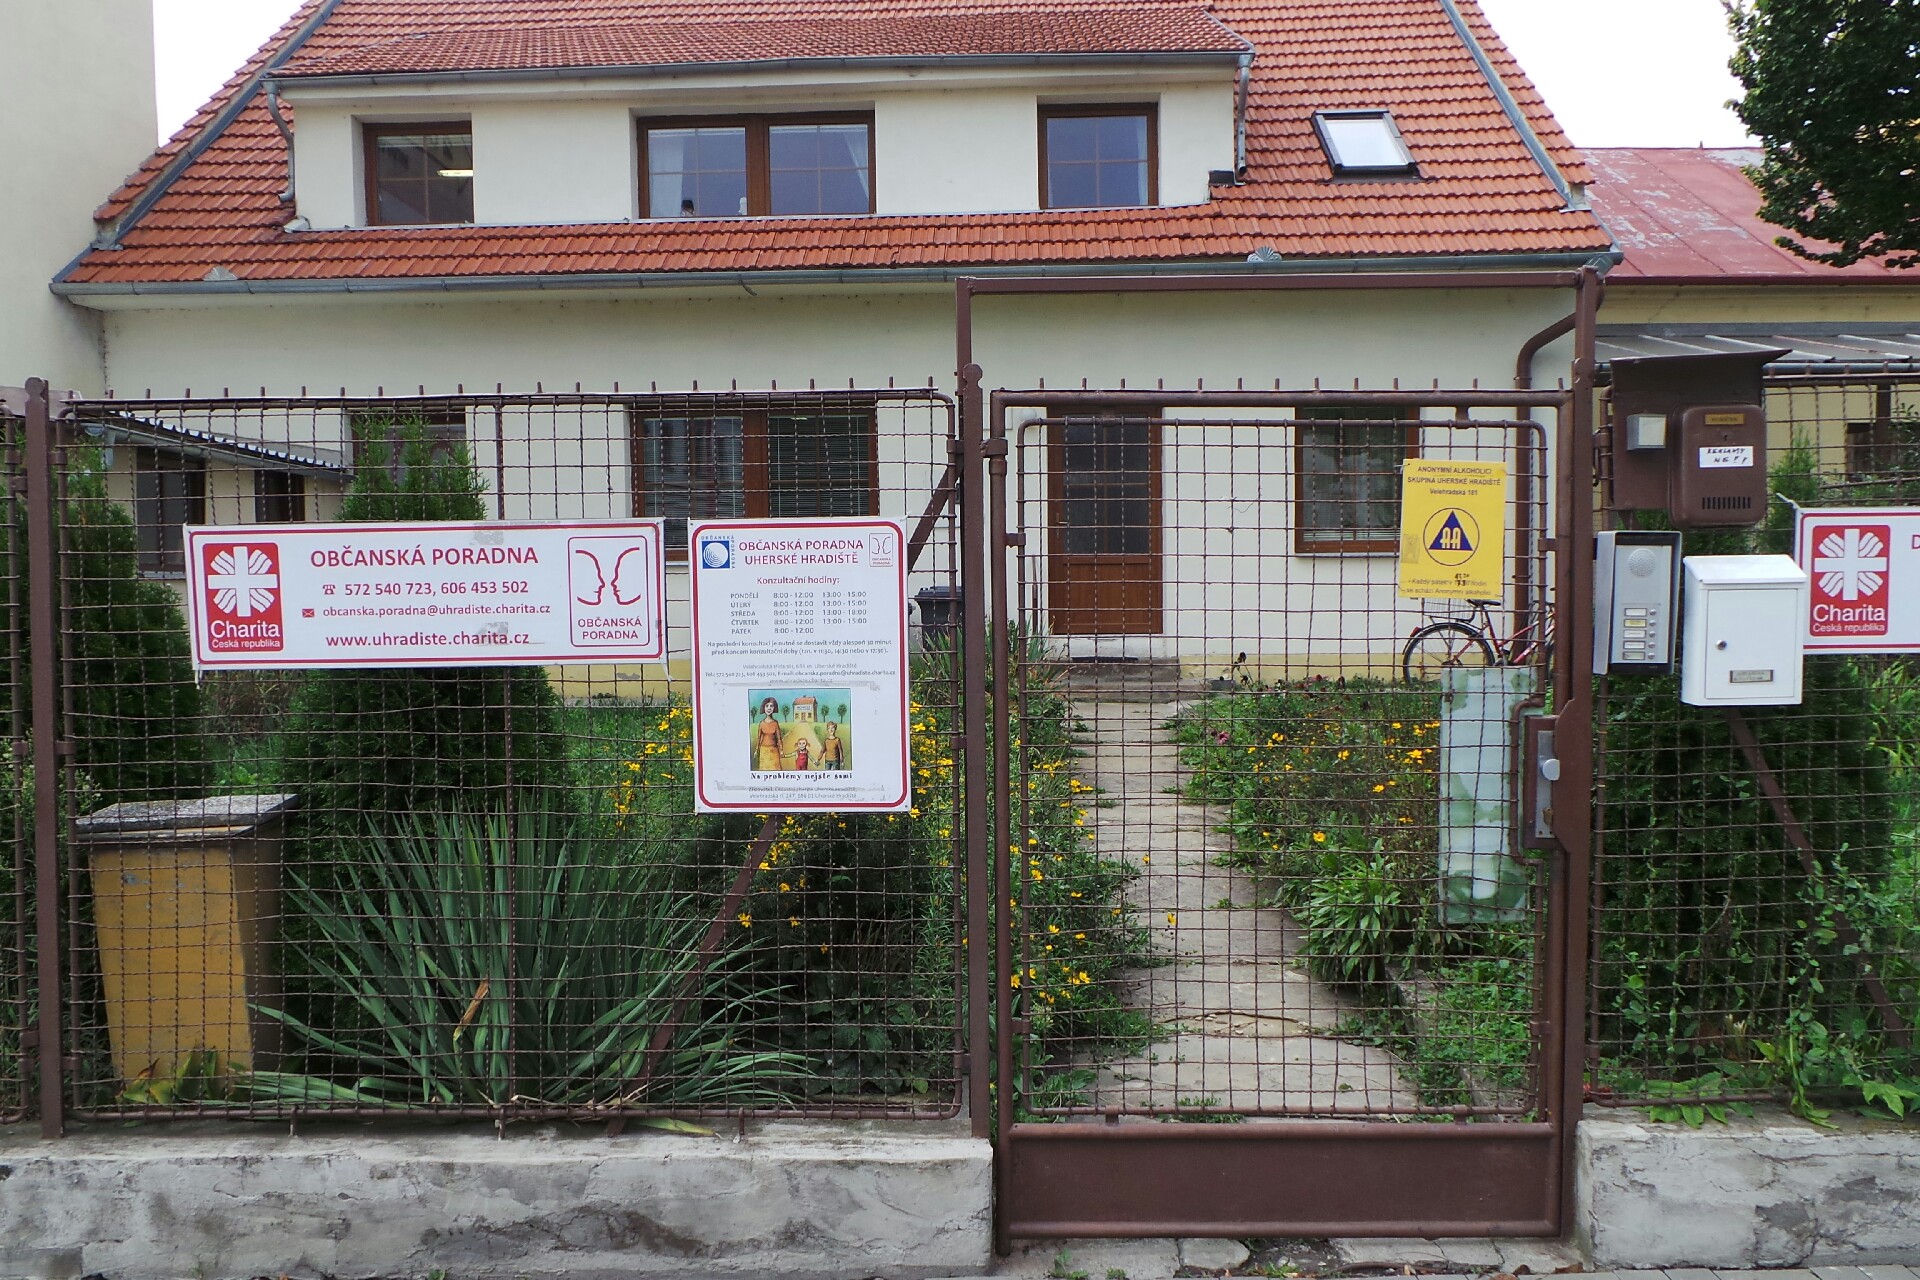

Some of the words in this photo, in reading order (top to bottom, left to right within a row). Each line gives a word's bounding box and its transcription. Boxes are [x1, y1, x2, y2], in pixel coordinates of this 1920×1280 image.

[1417, 466, 1453, 474] ANONYMNÍ
[1453, 467, 1492, 475] ALKOHOLICI
[1437, 477, 1468, 485] UHERSKÉ
[1469, 477, 1501, 486] HRADIŠTĚ
[1440, 527, 1461, 550] AA
[738, 538, 801, 551] OBČANSKÁ
[805, 539, 864, 550] PORADNA
[310, 545, 426, 567] OBČANSKÁ
[432, 546, 539, 566] PORADNA
[744, 553, 798, 565] UHERSKÉ
[800, 552, 859, 564] HRADIŠTĚ
[757, 575, 806, 585] Konzultační
[808, 575, 840, 585] hodiny:
[344, 583, 371, 596] 572
[375, 583, 401, 596] 540
[405, 582, 436, 598] 723,
[441, 582, 467, 595] 606
[471, 581, 498, 594] 453
[502, 580, 529, 594] 502
[730, 591, 759, 599] PONDĚLÍ
[730, 600, 751, 608] ÚTERÝ
[323, 604, 550, 618] obcanska.poradna@uhradiste.charita.cz
[1812, 604, 1886, 622] Charita
[577, 616, 642, 628] OBČANSKÁ
[731, 618, 760, 626] ČTVRTEK
[210, 620, 280, 639] Charita
[731, 627, 752, 635] PÁTEK
[1813, 623, 1842, 633] Česká
[1844, 623, 1885, 634] republika
[326, 631, 530, 646] www.uhradiste.charita.cz
[582, 630, 639, 640] PORADNA
[211, 638, 239, 649] Česká
[241, 638, 281, 650] republika
[716, 640, 740, 648] poslední
[763, 772, 802, 781] problémy
[804, 772, 831, 782] nejste
